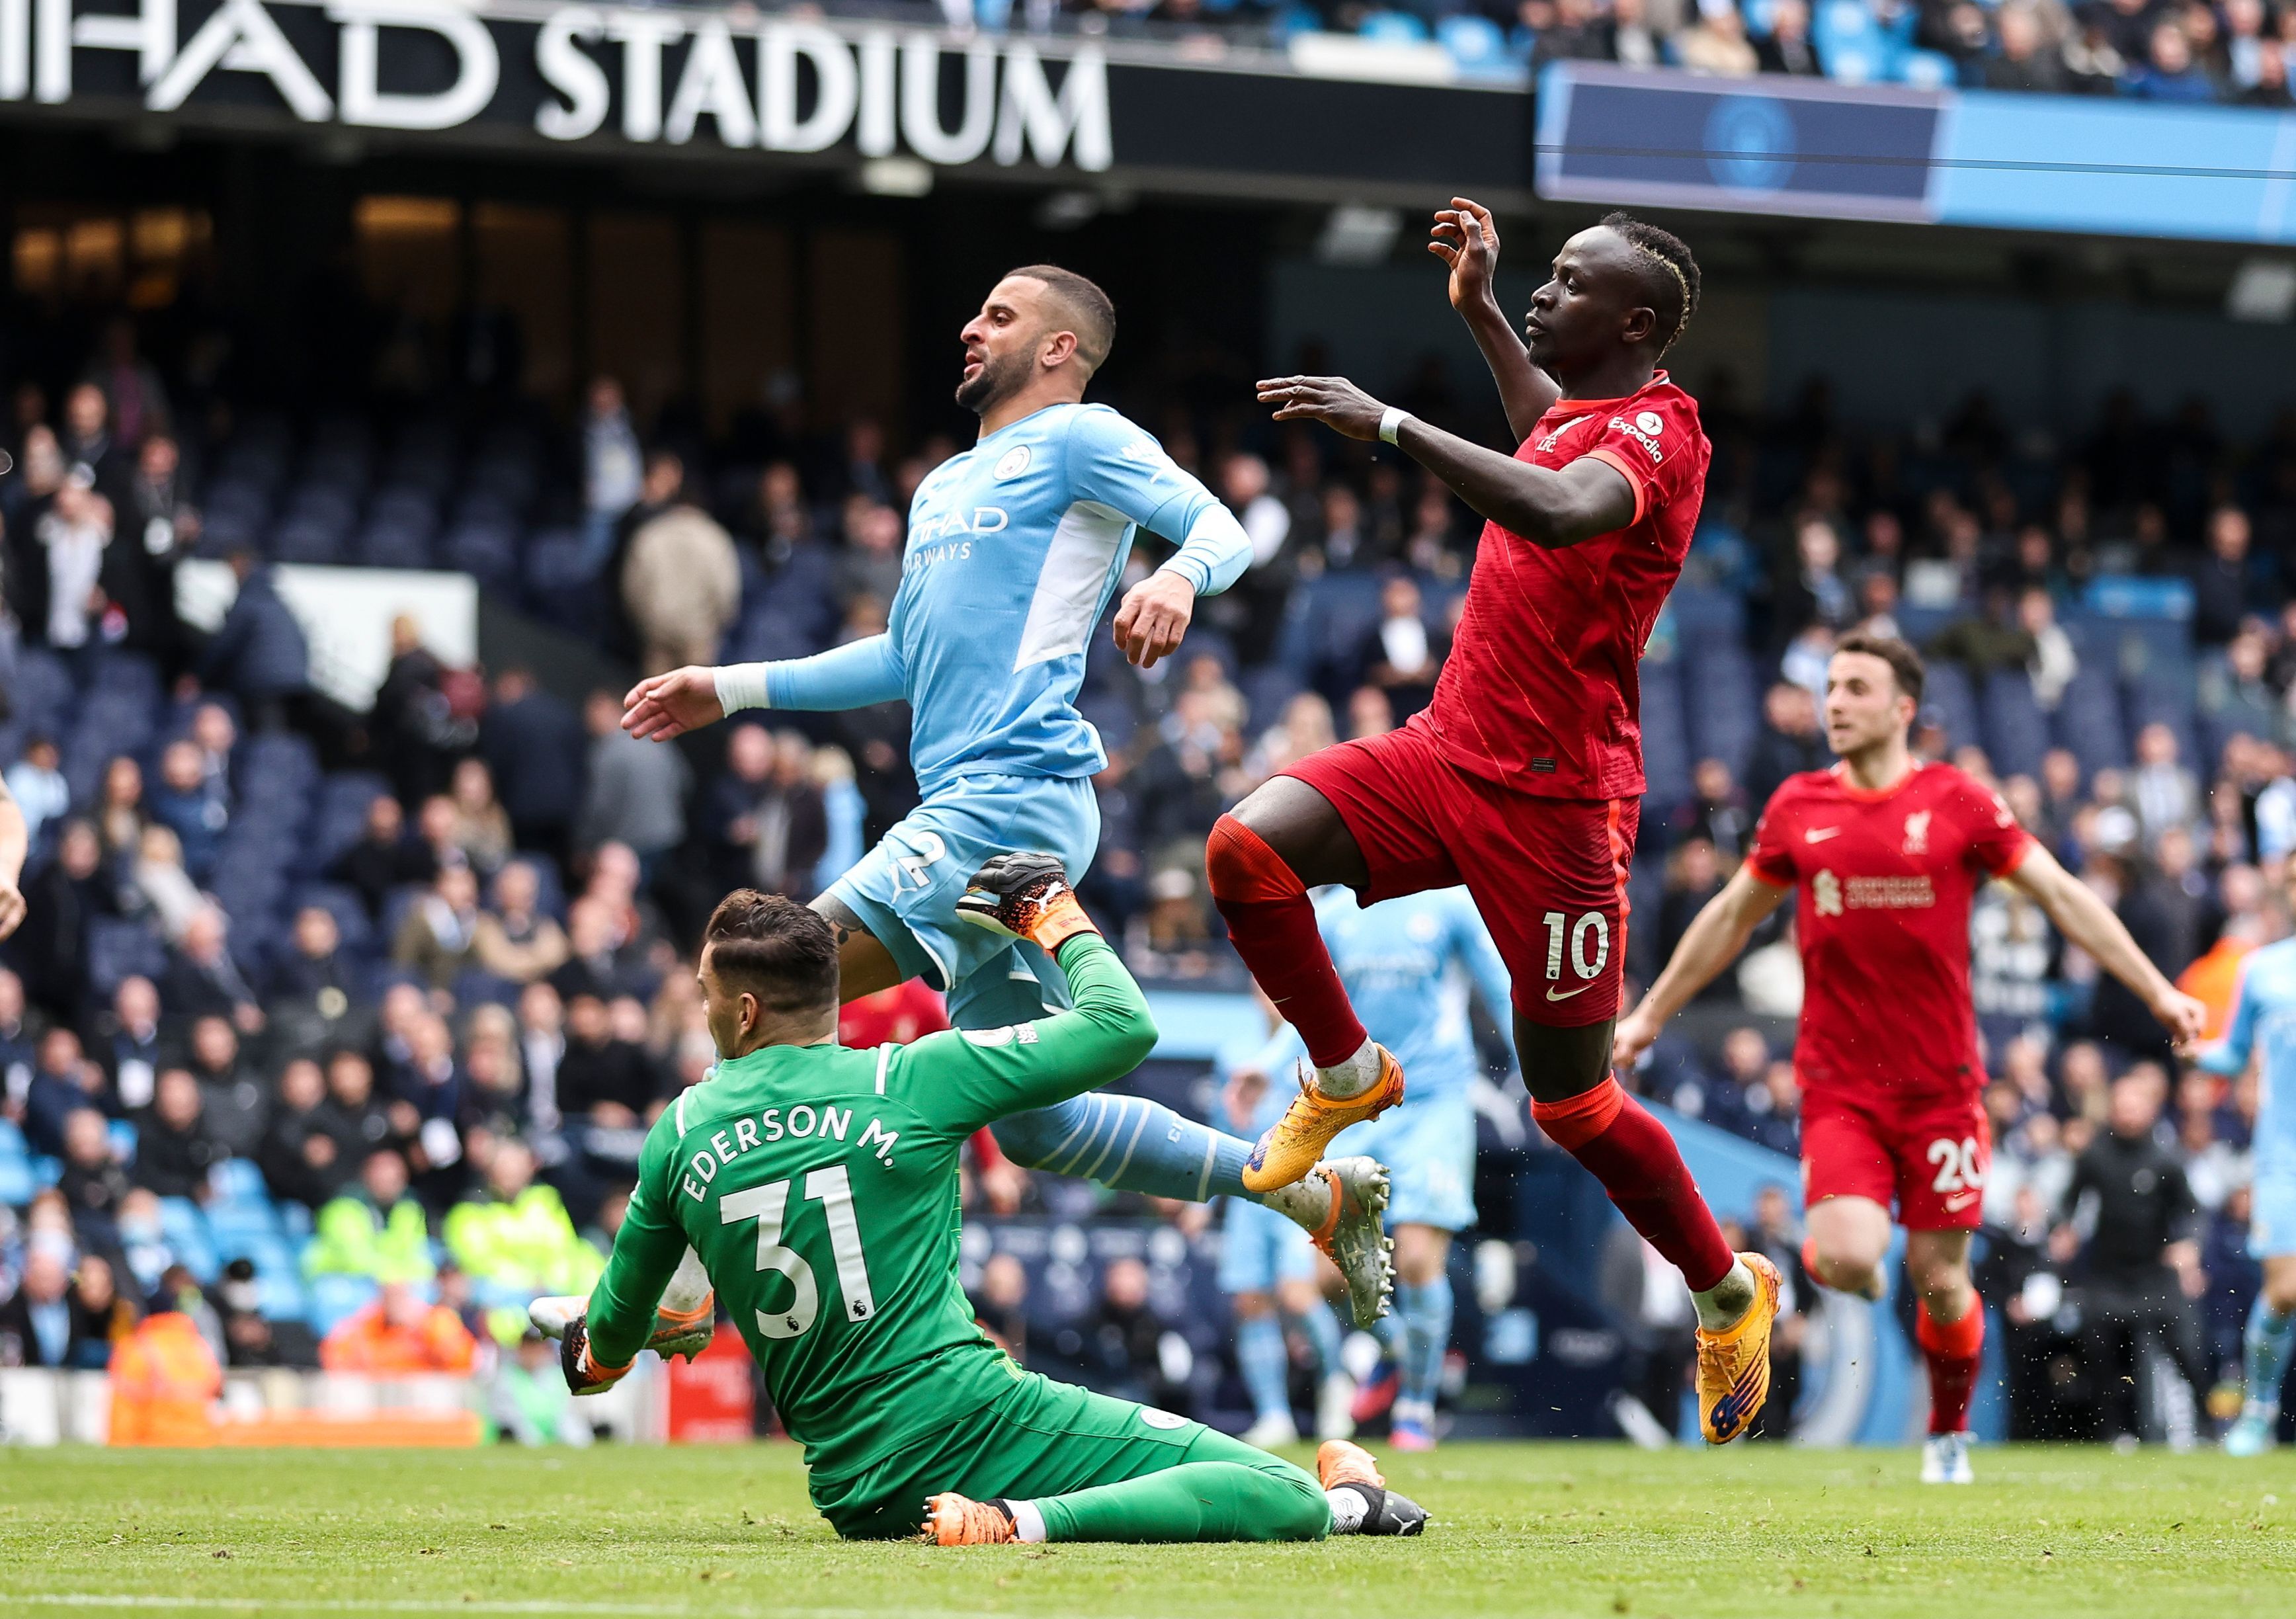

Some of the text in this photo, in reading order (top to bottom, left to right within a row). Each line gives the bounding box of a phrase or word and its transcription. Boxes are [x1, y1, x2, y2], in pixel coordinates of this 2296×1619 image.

[534, 11, 1114, 172] STADIUM
[1608, 416, 1664, 464] Expedia
[896, 831, 946, 888] 2
[1543, 911, 1609, 979] 10
[682, 1105, 900, 1203] EDERSON M.
[1926, 1136, 1985, 1193] 20
[719, 1163, 876, 1339] 31
